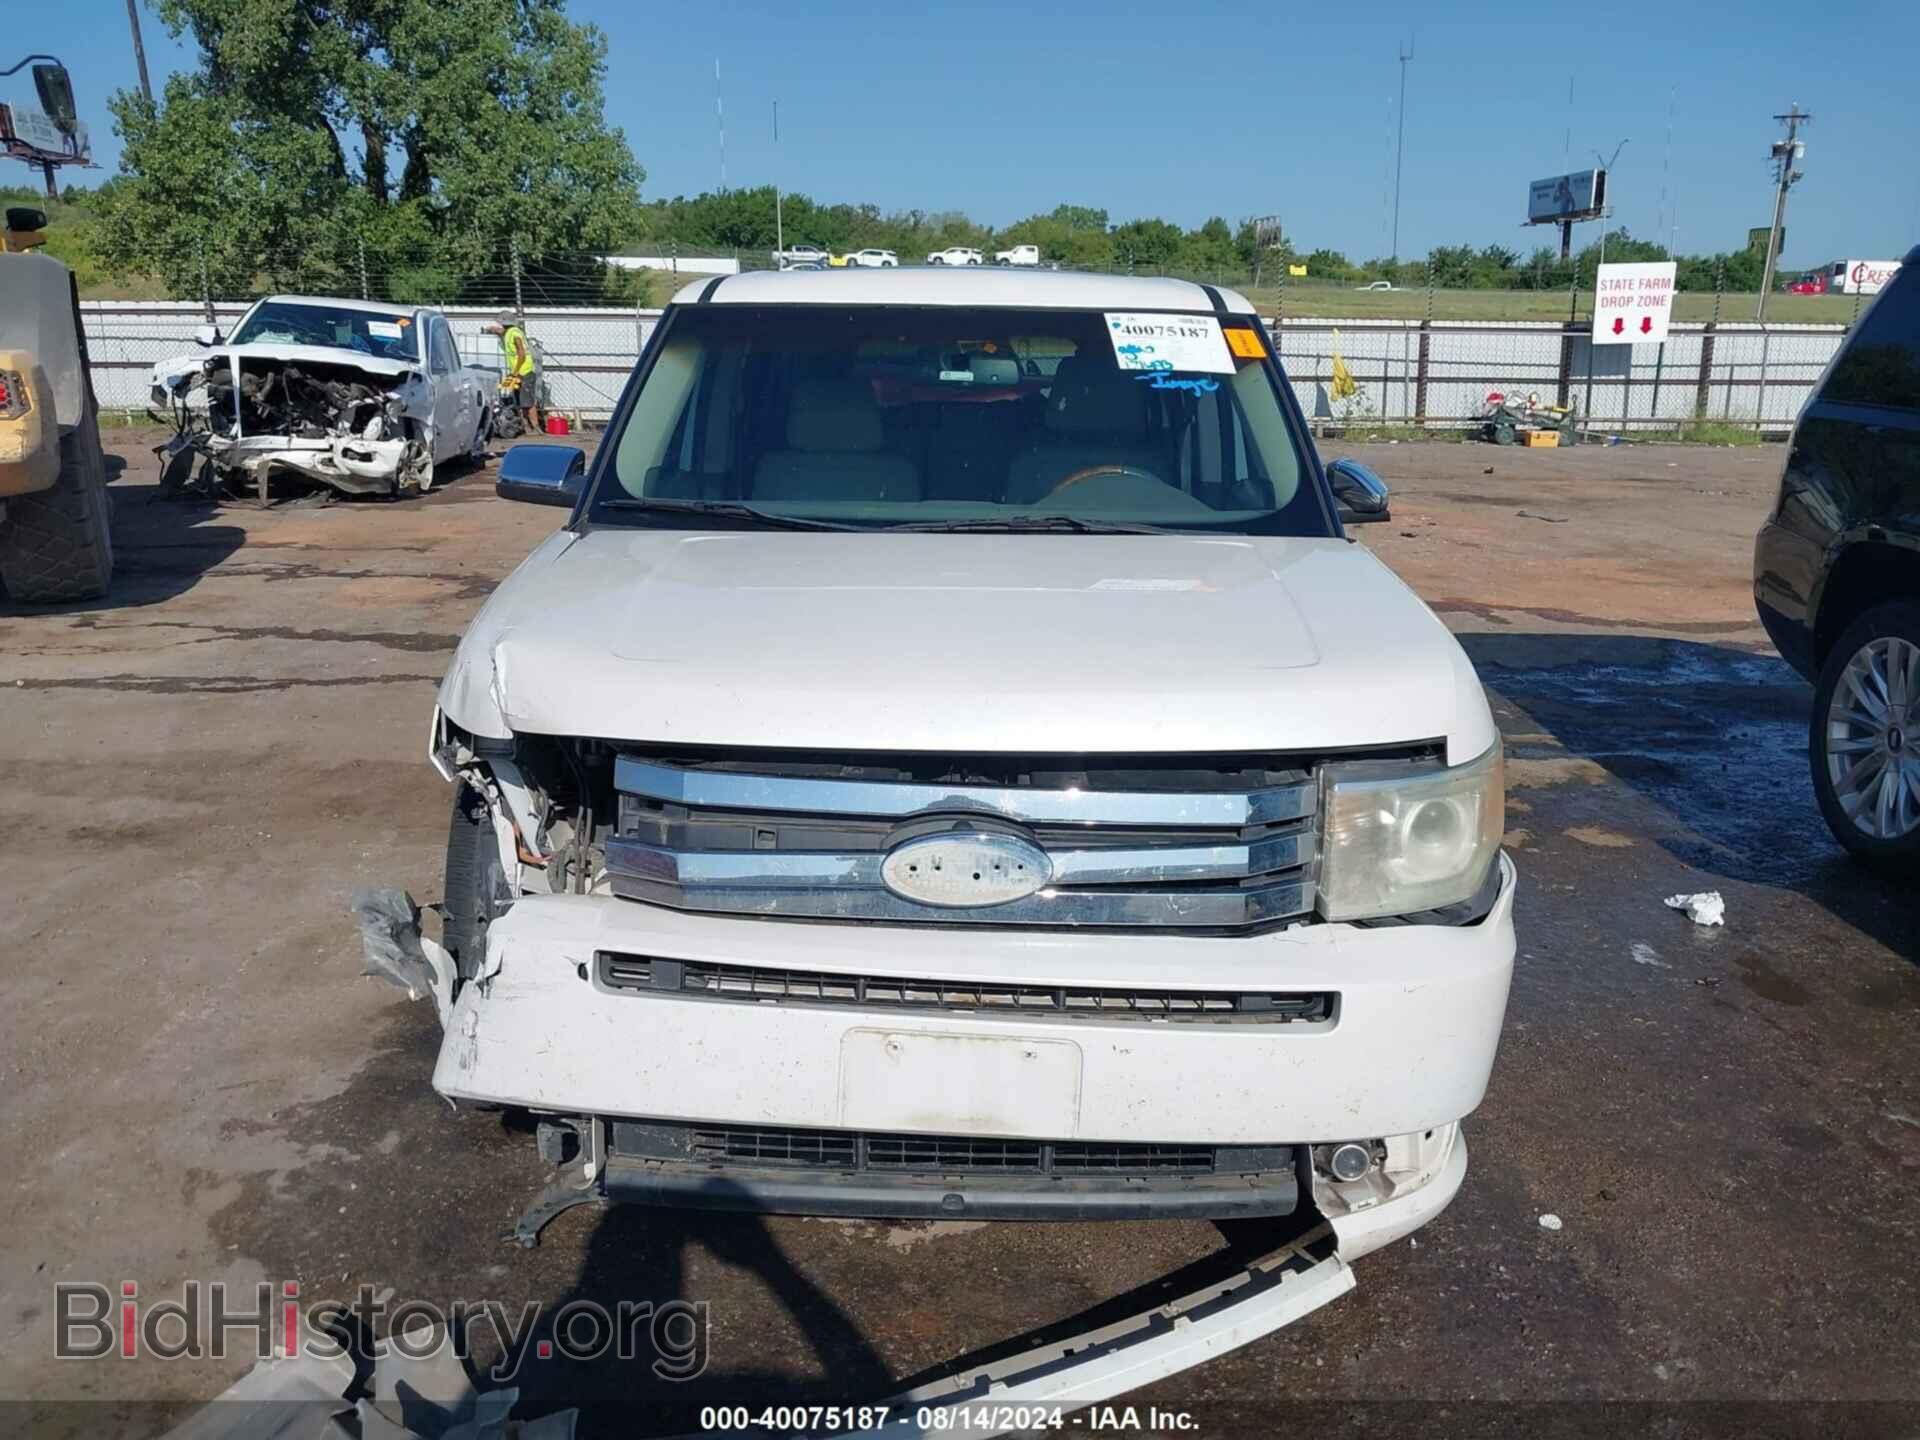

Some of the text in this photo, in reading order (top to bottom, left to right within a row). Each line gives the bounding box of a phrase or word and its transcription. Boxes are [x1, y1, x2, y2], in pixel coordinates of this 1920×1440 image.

[1601, 278, 1671, 291] STATE FARM
[1601, 295, 1667, 308] DROP ZONE
[1121, 325, 1209, 338] 40075187
